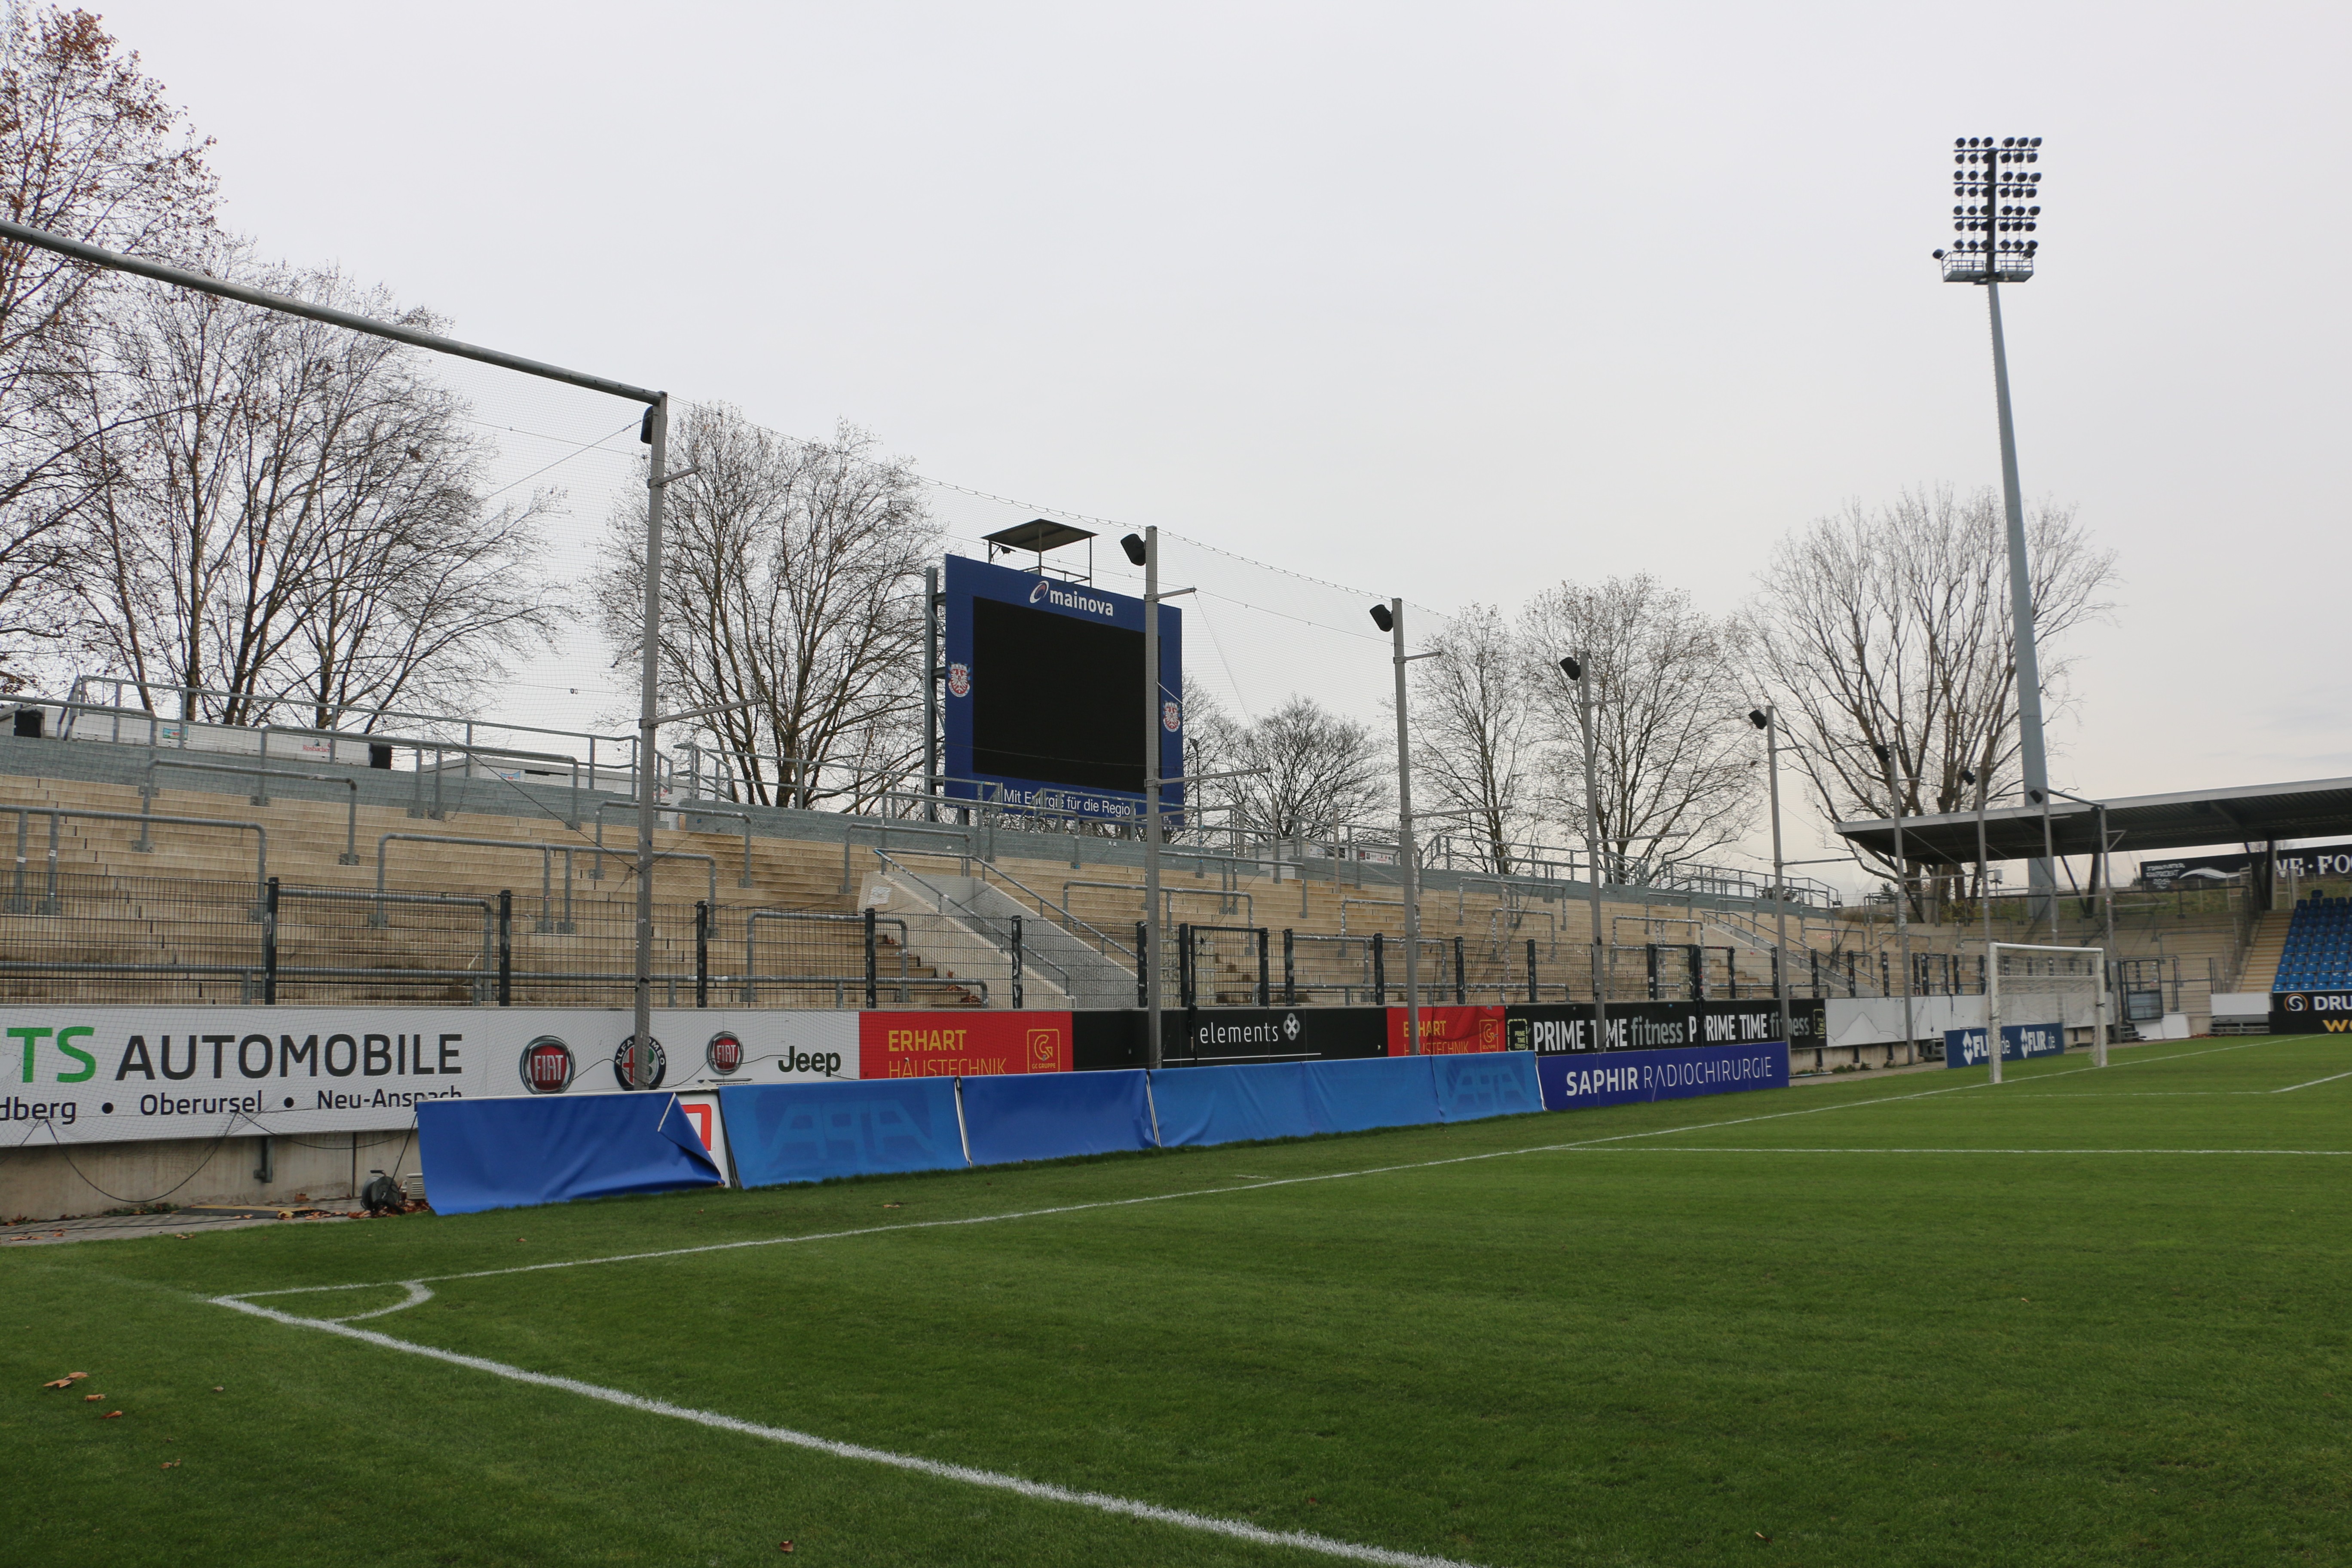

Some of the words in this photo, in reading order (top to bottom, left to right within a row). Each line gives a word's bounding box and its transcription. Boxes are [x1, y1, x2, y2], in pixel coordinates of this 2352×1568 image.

[1050, 589, 1113, 616] mainova
[1004, 789, 1021, 803] Mit
[1067, 796, 1081, 810] für
[1084, 801, 1099, 812] die
[1200, 1022, 1278, 1043] elements
[1403, 1020, 1446, 1037] EHART
[1533, 1020, 1586, 1052] PRIME
[1590, 1019, 1627, 1048] TME
[1631, 1015, 1683, 1046] fitness
[1739, 1014, 1768, 1039] TIME
[1770, 1011, 1810, 1037] finess
[616, 1040, 633, 1066] ALFA
[717, 1044, 736, 1063] FIAT
[888, 1030, 966, 1051] ERHART
[115, 1034, 462, 1081] AUTOMOBILE
[534, 1055, 564, 1081] FIAT
[778, 1046, 841, 1077] Jeep
[889, 1058, 1006, 1078] HAUSTECHNIK
[1566, 1067, 1639, 1096] SAPHIR
[1644, 1057, 1773, 1102] RADIOCHIRURGIE
[141, 1090, 261, 1115] Oberursel
